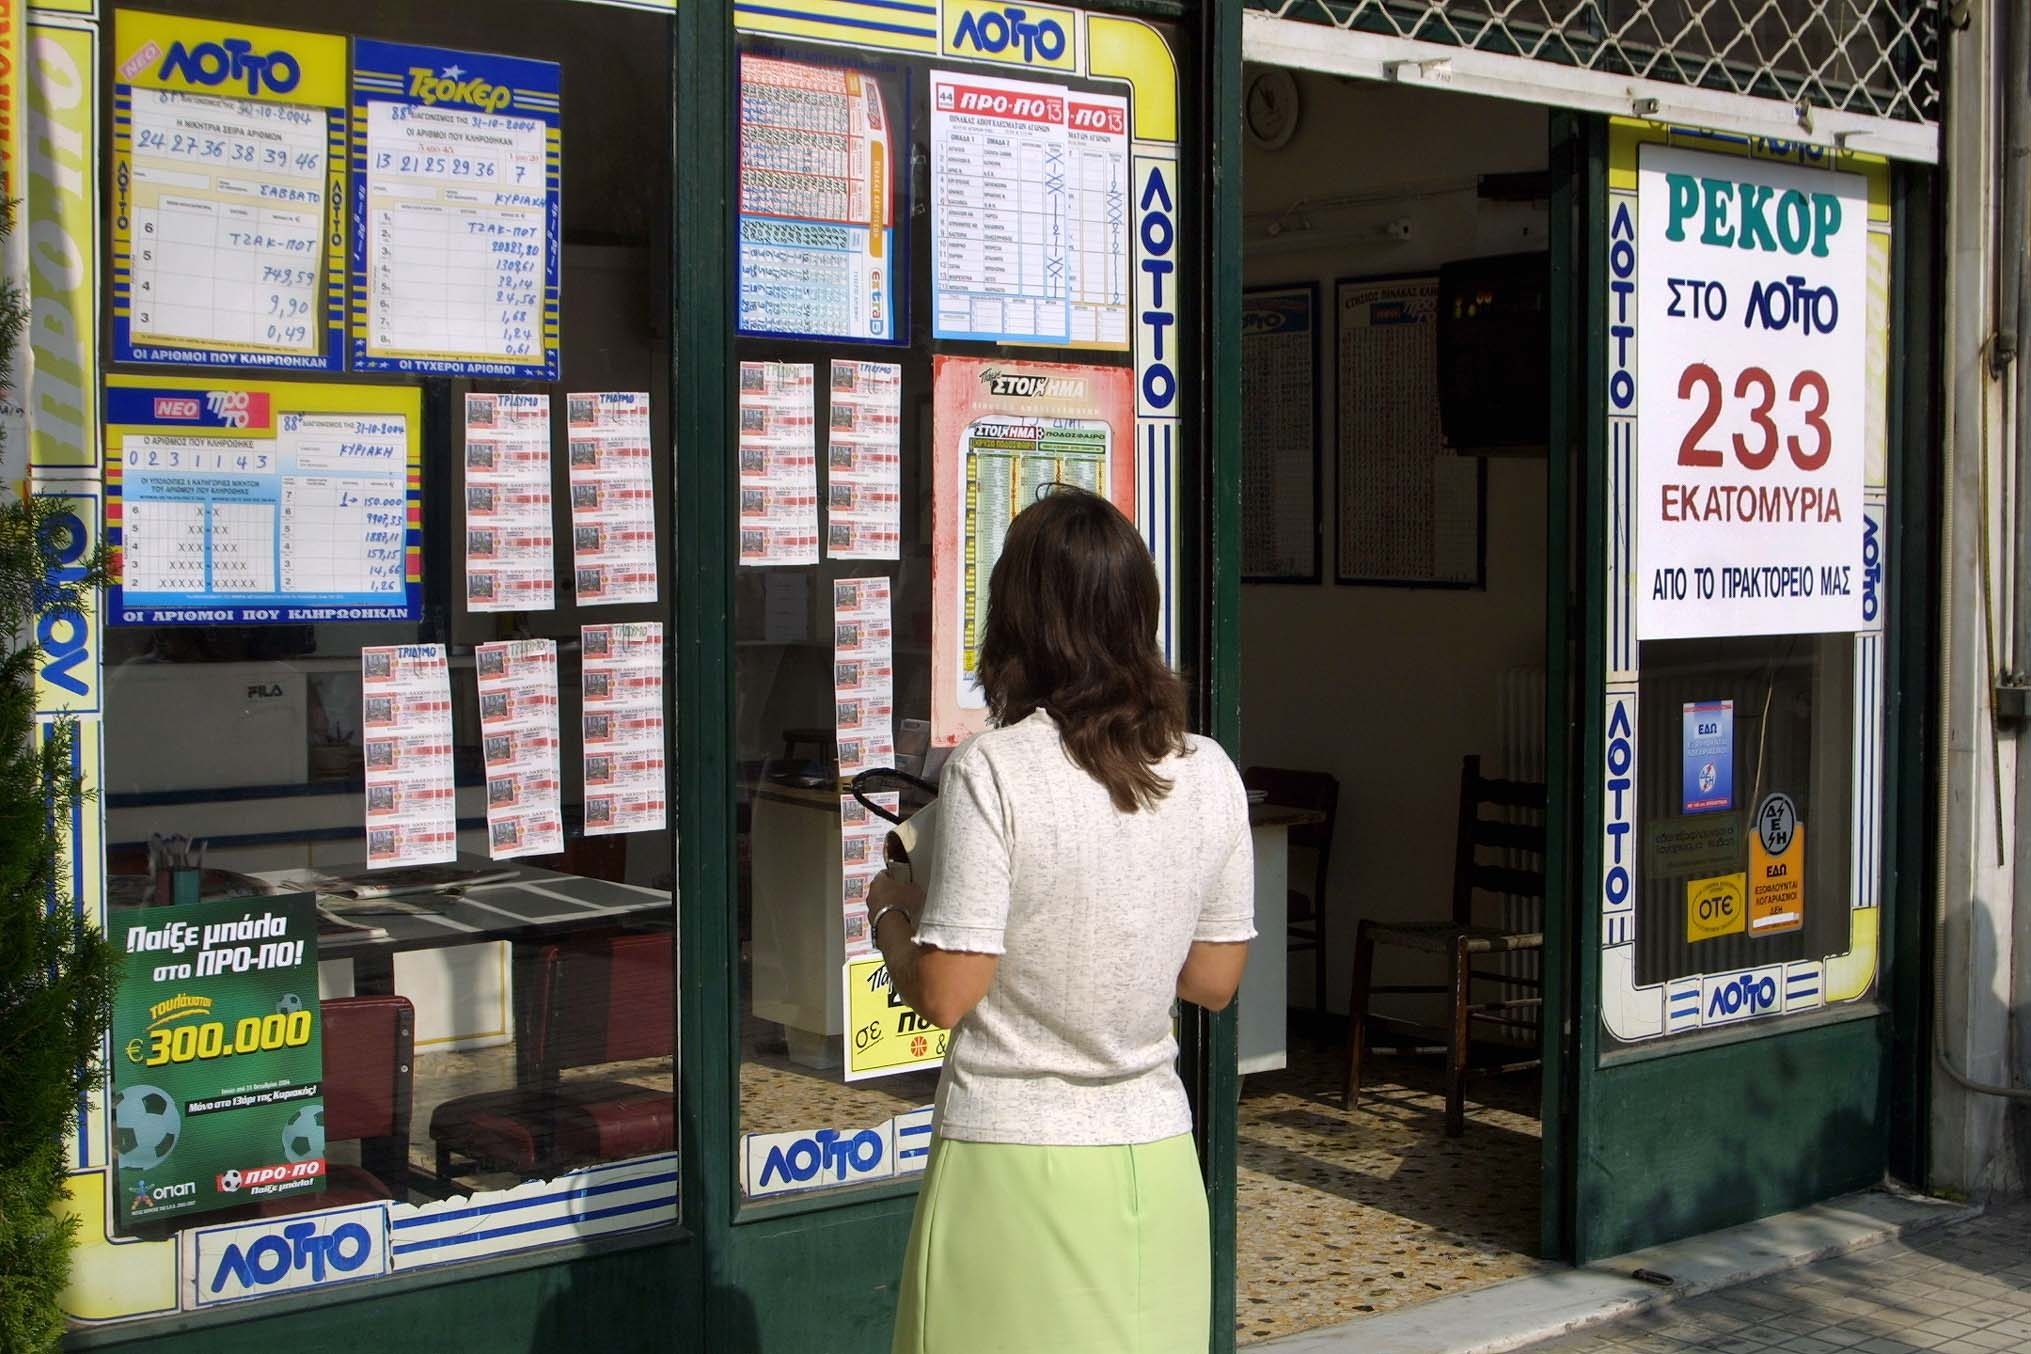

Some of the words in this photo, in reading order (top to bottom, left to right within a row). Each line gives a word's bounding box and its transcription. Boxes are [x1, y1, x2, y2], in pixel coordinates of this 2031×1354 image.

[953, 8, 1065, 62] ΛΟΤΤΟ
[159, 38, 300, 95] ΛΟΤΤΟ
[138, 130, 165, 148] 24
[170, 135, 198, 154] 27
[200, 140, 225, 157] 36
[231, 144, 254, 161] 38
[264, 150, 287, 166] 39
[295, 153, 319, 169] 46
[376, 153, 392, 168] 13
[401, 156, 418, 172] 21
[425, 157, 446, 173] 25
[452, 158, 470, 175] 29
[475, 162, 495, 176] 36
[118, 161, 128, 230] ΛΟΤΤΟ
[332, 180, 342, 246] ΛΟΤΤΟ
[144, 222, 153, 233] 6
[1665, 173, 1842, 257] ΡΕΚΟΡ
[143, 250, 151, 261] 5
[142, 281, 150, 291] 4
[263, 266, 315, 286] 749,59
[1141, 166, 1175, 409] ΛΟΤΤΟ
[140, 312, 149, 323] 3
[1611, 202, 1634, 409] ΛΟΤΤΟ
[1667, 278, 1727, 321] ΣΤΟ
[1744, 275, 1838, 336] ΛΟΤΤΟ
[267, 325, 305, 343] 0,49
[133, 349, 148, 359] ΟΙ
[151, 350, 207, 363] ΑΡΙΘΜΟΙ
[211, 351, 237, 364] ΠΟΥ
[240, 353, 327, 369] ΚΛΗΡΩΘΗΚΑΝ
[399, 360, 412, 370] ΟΙ
[420, 360, 464, 373] ΤΥΧΕΡΟΙ
[466, 363, 516, 375] ΑΡΙΘΜΟΙ
[990, 374, 1085, 397] ΣΤΟΙΧΗΜΑ
[157, 399, 197, 417] ΝΕΟ
[1677, 362, 1832, 471] 233
[975, 424, 1037, 438] ΣΤΟΙΧΗΜΑ
[1661, 485, 1842, 523] ΕΚΑΤΟΜΥΡΙΑ
[1652, 568, 1687, 600] ΑΠΟ
[1694, 568, 1715, 600] ΤΟ
[1721, 566, 1814, 599] ΠΡΑΚΤΟΡΕΙΟ
[1820, 566, 1851, 595] ΜΑΣ
[123, 609, 144, 623] ΟΙ
[153, 608, 234, 622] ΑΡΙΘΜΟΙ
[242, 609, 280, 621] ΠΟΥ
[288, 607, 409, 622] ΚΛΗΡΩΘΗΚΑΝ
[1698, 723, 1717, 735] ΕΔΩ
[1606, 701, 1631, 905] ΛΟΤΤΟ
[1766, 864, 1787, 878] ΕΔΩ
[127, 920, 199, 954] Παίξε
[202, 912, 287, 950] μπάλα
[153, 962, 191, 982] στο
[196, 940, 304, 977] ΠΡΟ-ΠΟ!
[1708, 974, 1776, 1018] ΛΟΤΤΟ
[189, 1100, 213, 1113] Μόνο
[214, 1099, 231, 1109] στο
[273, 1085, 317, 1100] Κυριακής!
[760, 1129, 883, 1187] ΛΟΤΤΟ
[211, 1222, 371, 1293] ΛΟΤΤΟ
